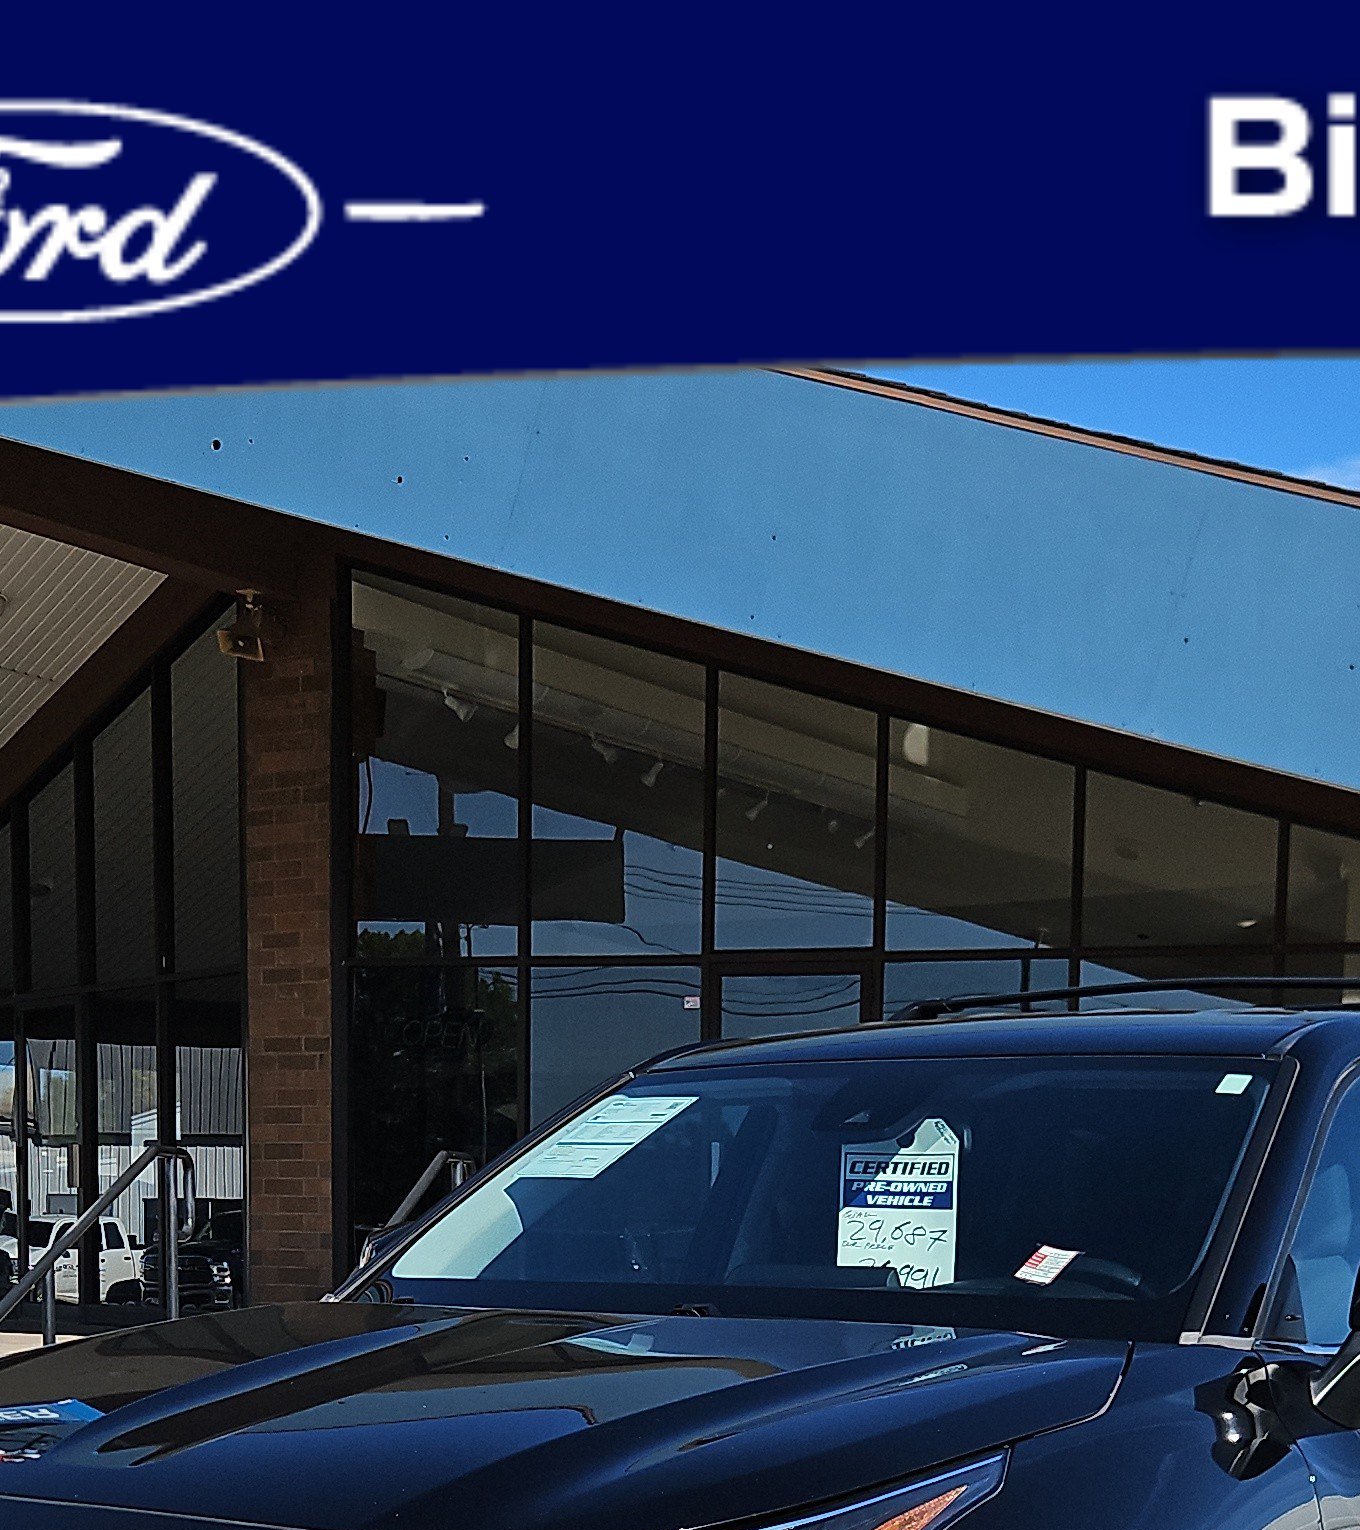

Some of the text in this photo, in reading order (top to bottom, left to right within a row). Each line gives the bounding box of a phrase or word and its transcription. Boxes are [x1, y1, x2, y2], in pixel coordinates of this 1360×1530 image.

[848, 1160, 950, 1175] CERTIFIED
[851, 1181, 947, 1193] PRE-OWNED
[866, 1195, 934, 1206] VEHICLE
[846, 1219, 949, 1251] 29,687
